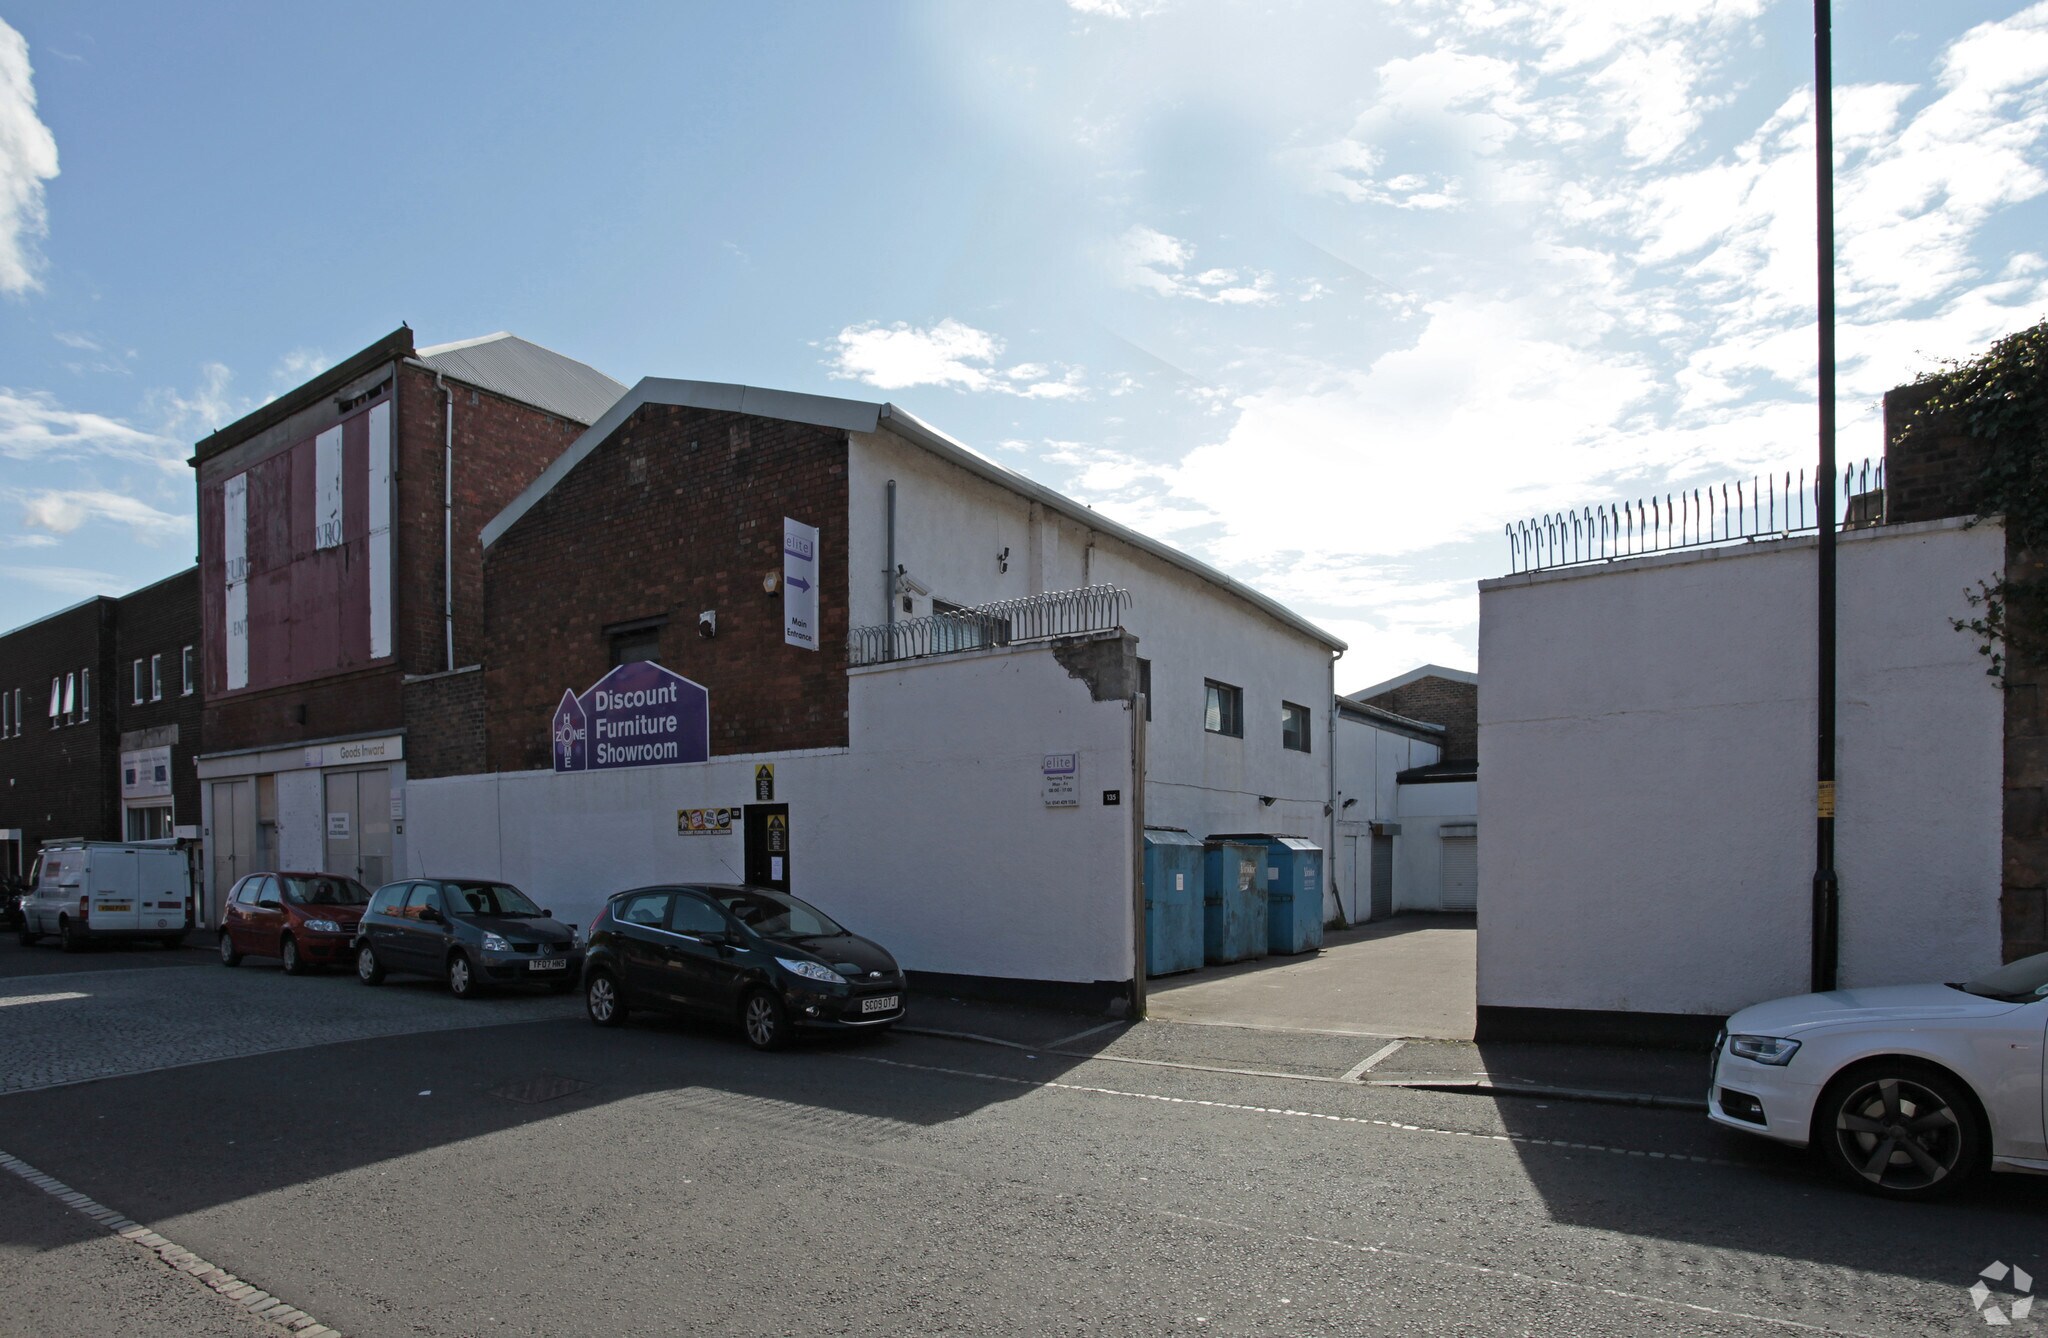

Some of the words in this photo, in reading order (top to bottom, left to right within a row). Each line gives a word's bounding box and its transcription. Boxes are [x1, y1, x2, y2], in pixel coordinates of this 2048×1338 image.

[786, 537, 809, 554] elite
[792, 616, 808, 629] Main
[786, 628, 813, 643] Entrance
[595, 682, 678, 712] Discount
[596, 713, 678, 739] Furniture
[556, 727, 585, 744] ZONE
[340, 745, 361, 759] Goods
[362, 742, 385, 756] Inward
[596, 740, 678, 764] Showroom
[1046, 757, 1071, 768] elite
[533, 960, 551, 969] TF07
[552, 959, 565, 967] HNS
[865, 999, 882, 1011] SC09
